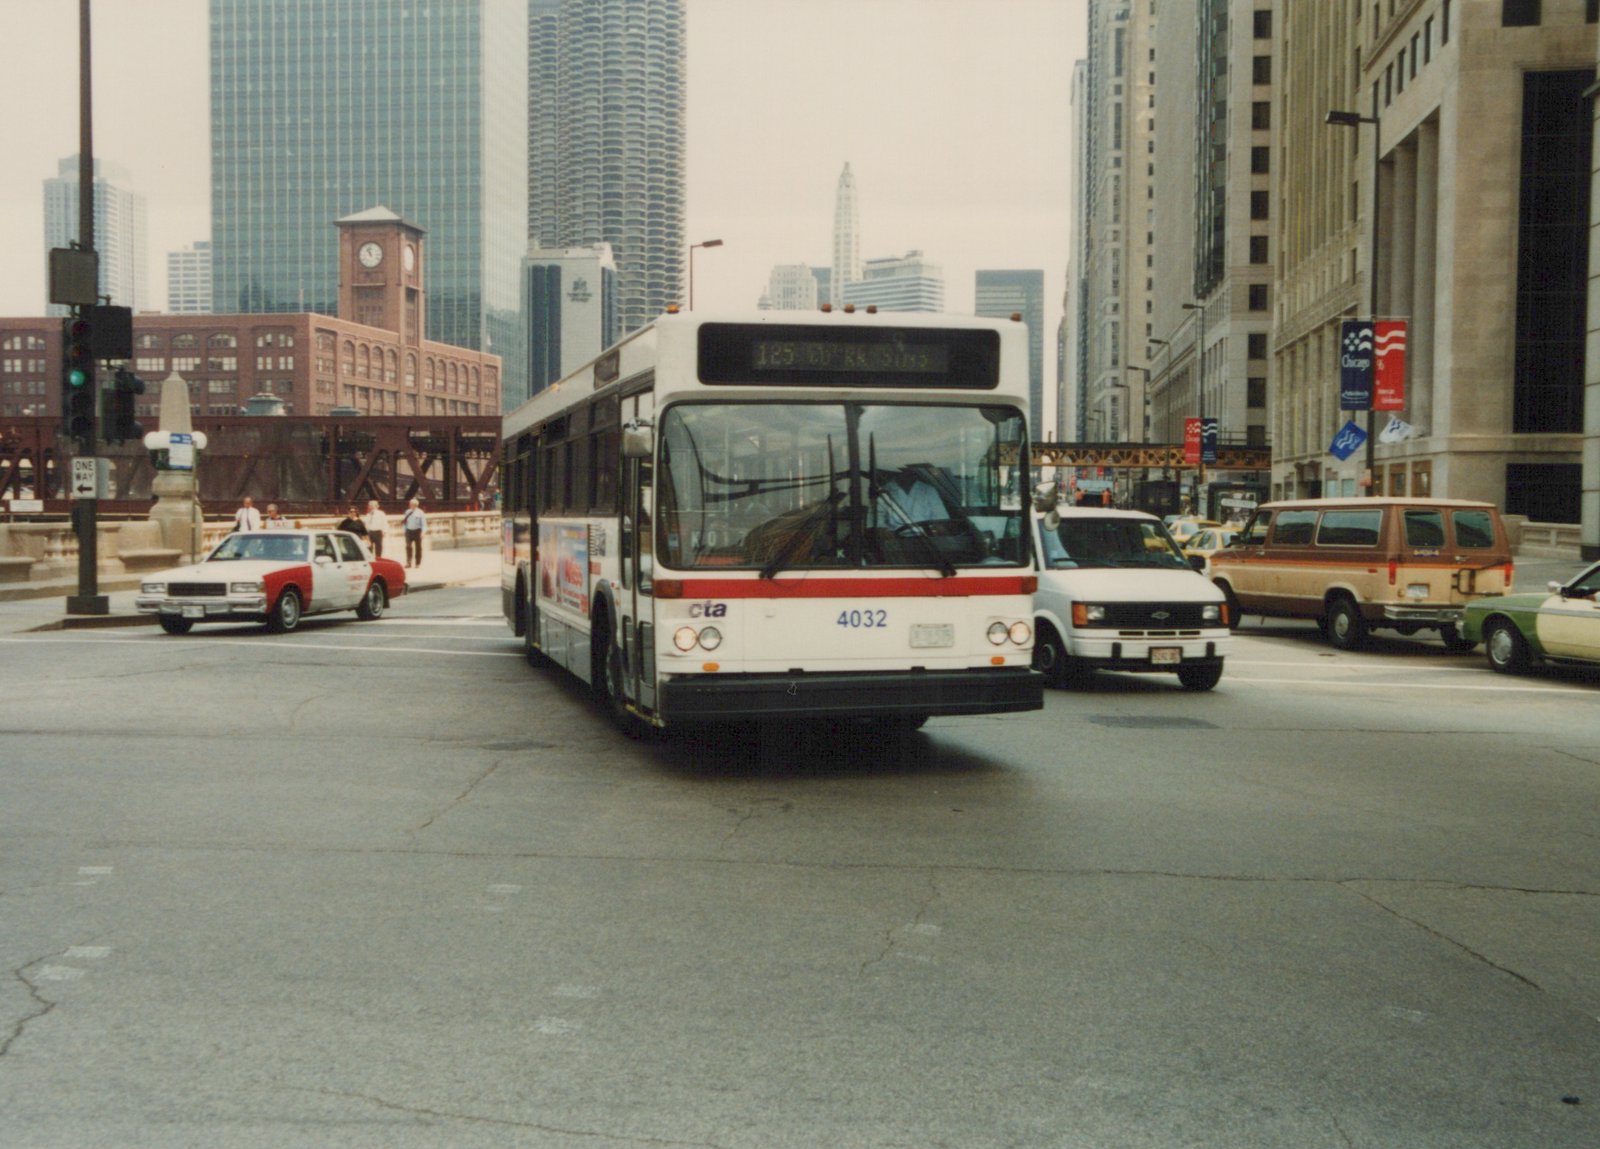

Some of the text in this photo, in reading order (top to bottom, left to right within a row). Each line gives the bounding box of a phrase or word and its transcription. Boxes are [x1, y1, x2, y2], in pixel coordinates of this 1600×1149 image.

[757, 343, 795, 366] 125
[1342, 354, 1370, 371] Chicago
[75, 461, 94, 471] ONE
[688, 601, 727, 617] cta
[837, 610, 887, 628] 4032
